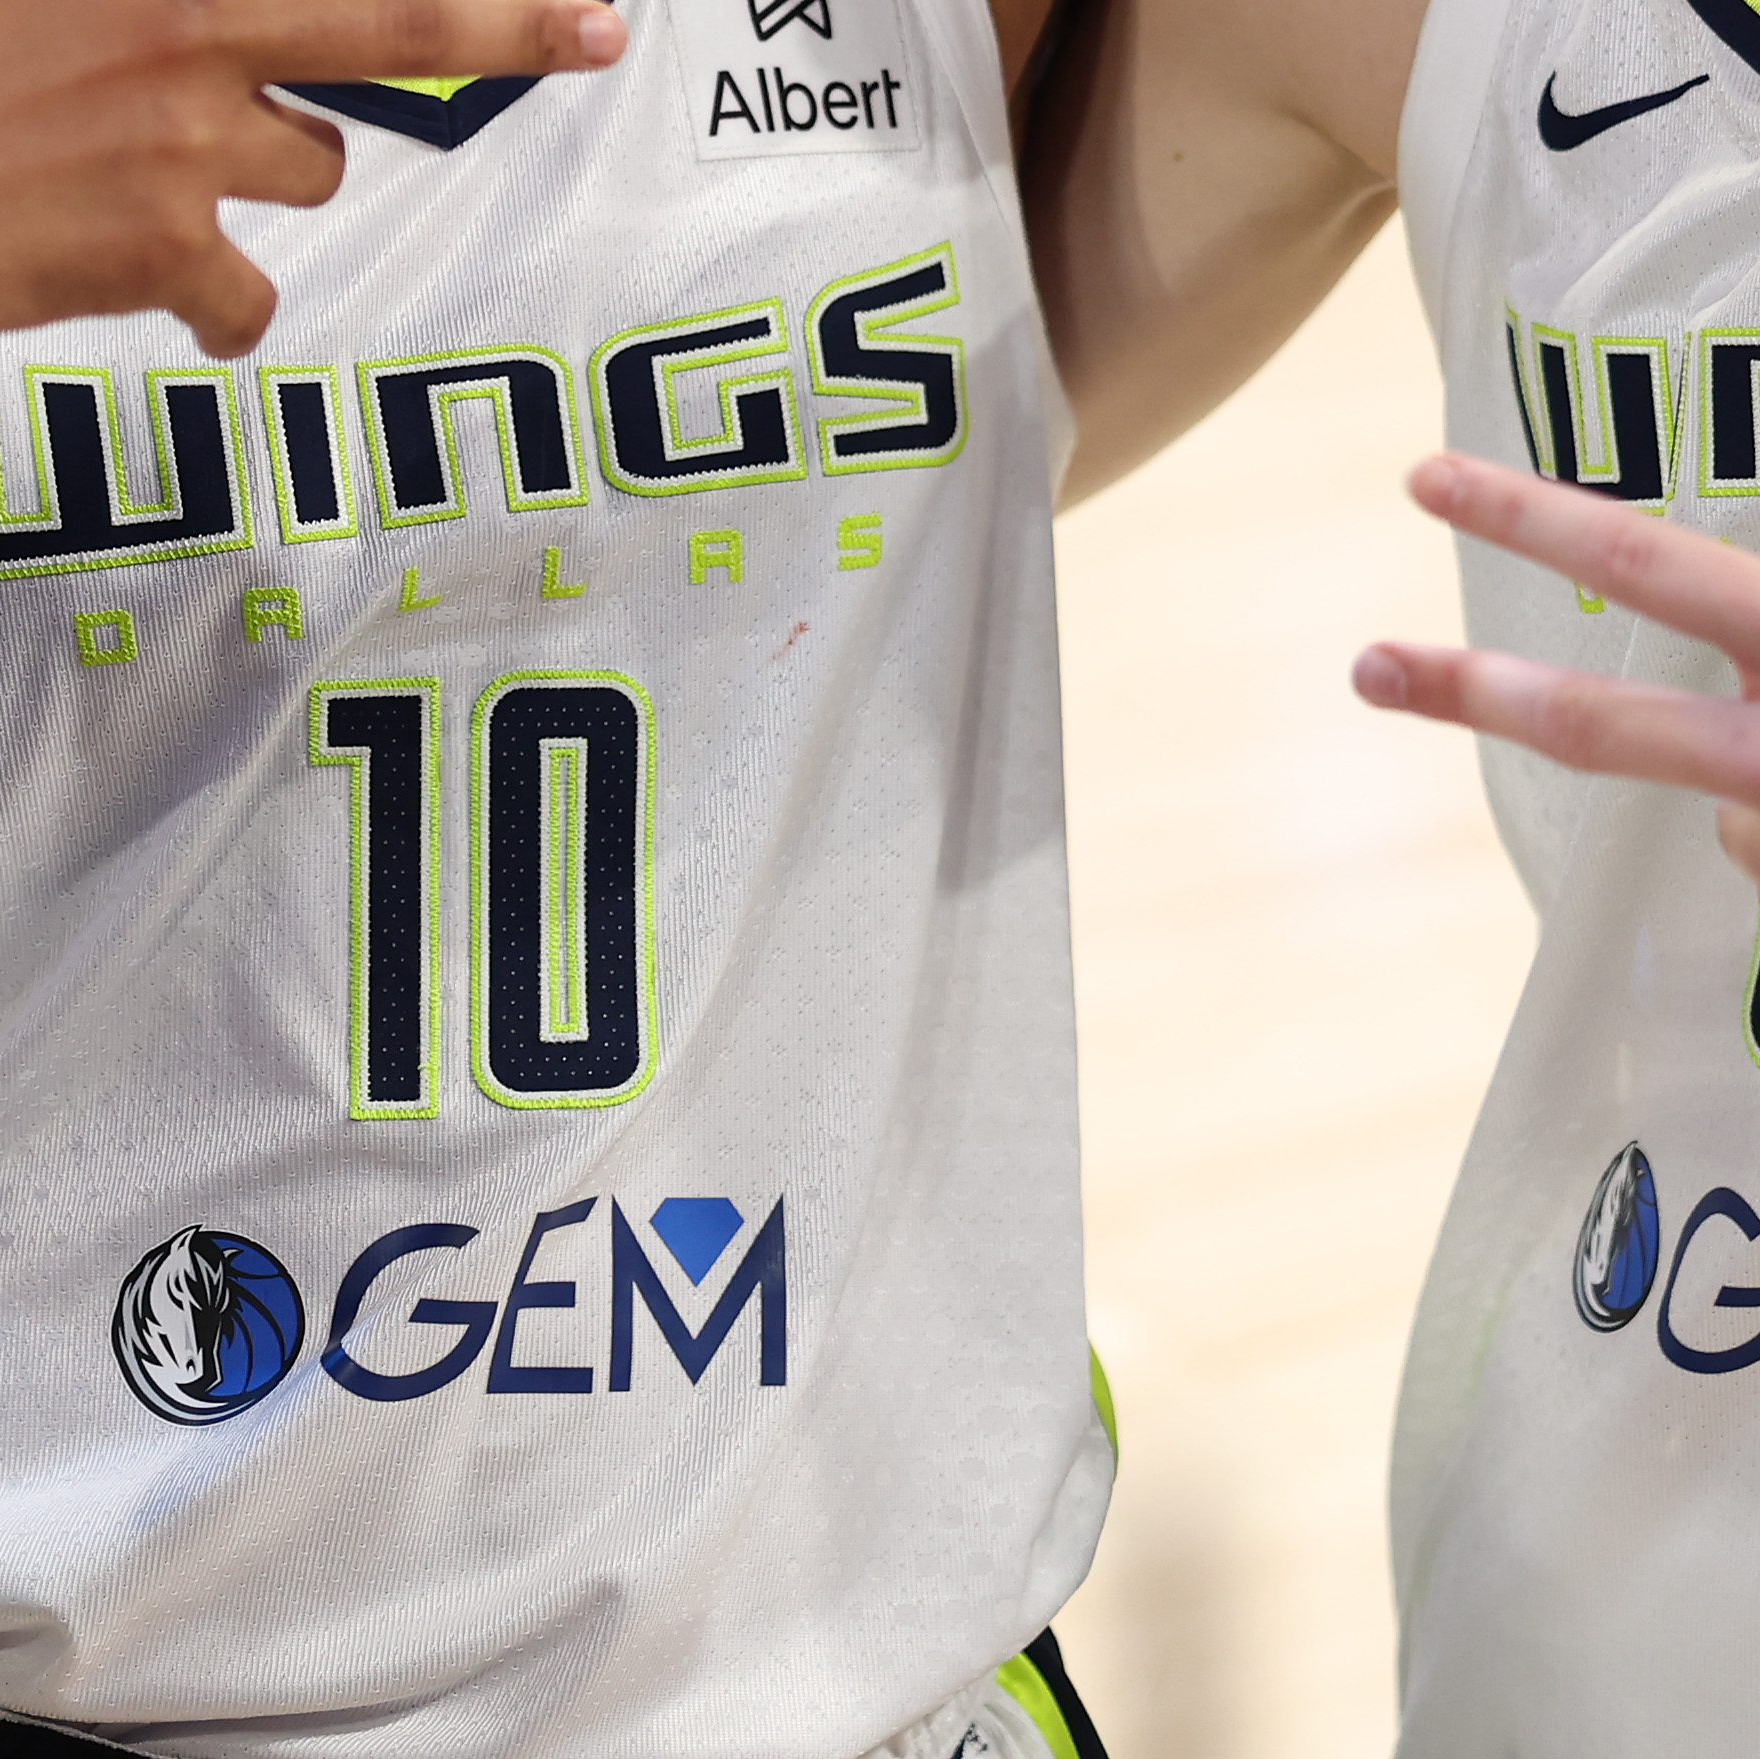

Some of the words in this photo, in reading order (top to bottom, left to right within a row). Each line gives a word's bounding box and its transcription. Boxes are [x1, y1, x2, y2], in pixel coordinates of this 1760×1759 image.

[707, 67, 902, 138] Albert
[73, 514, 882, 667] DALLAS
[307, 669, 657, 1121] 10
[320, 1193, 788, 1403] GEM
